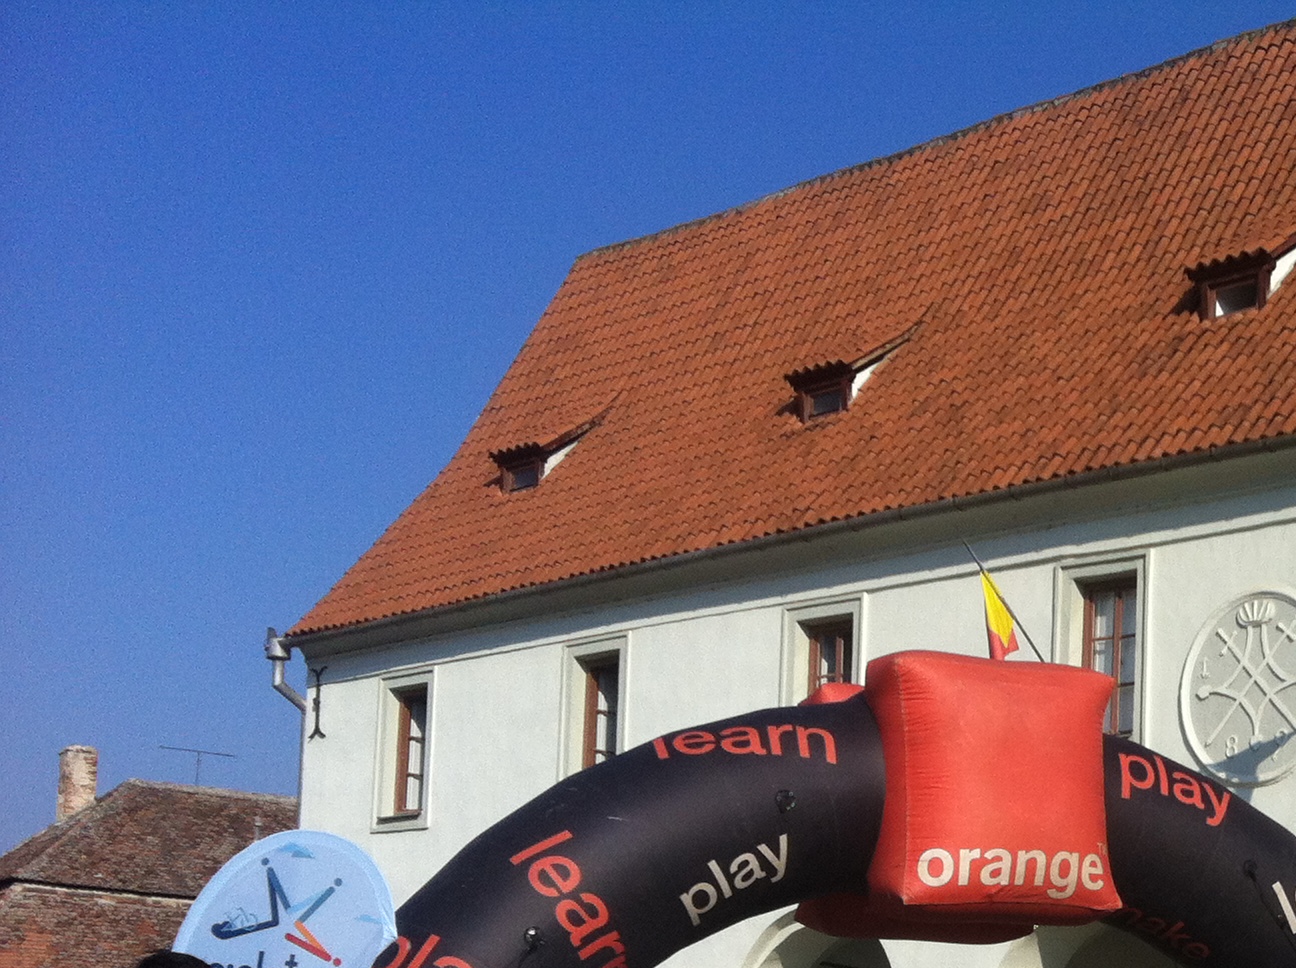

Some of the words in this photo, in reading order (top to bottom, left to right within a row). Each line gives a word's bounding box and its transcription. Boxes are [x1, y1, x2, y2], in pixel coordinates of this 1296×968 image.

[652, 724, 839, 765] learn
[1118, 752, 1232, 827] play
[679, 833, 789, 927] play
[916, 847, 1105, 900] orange
